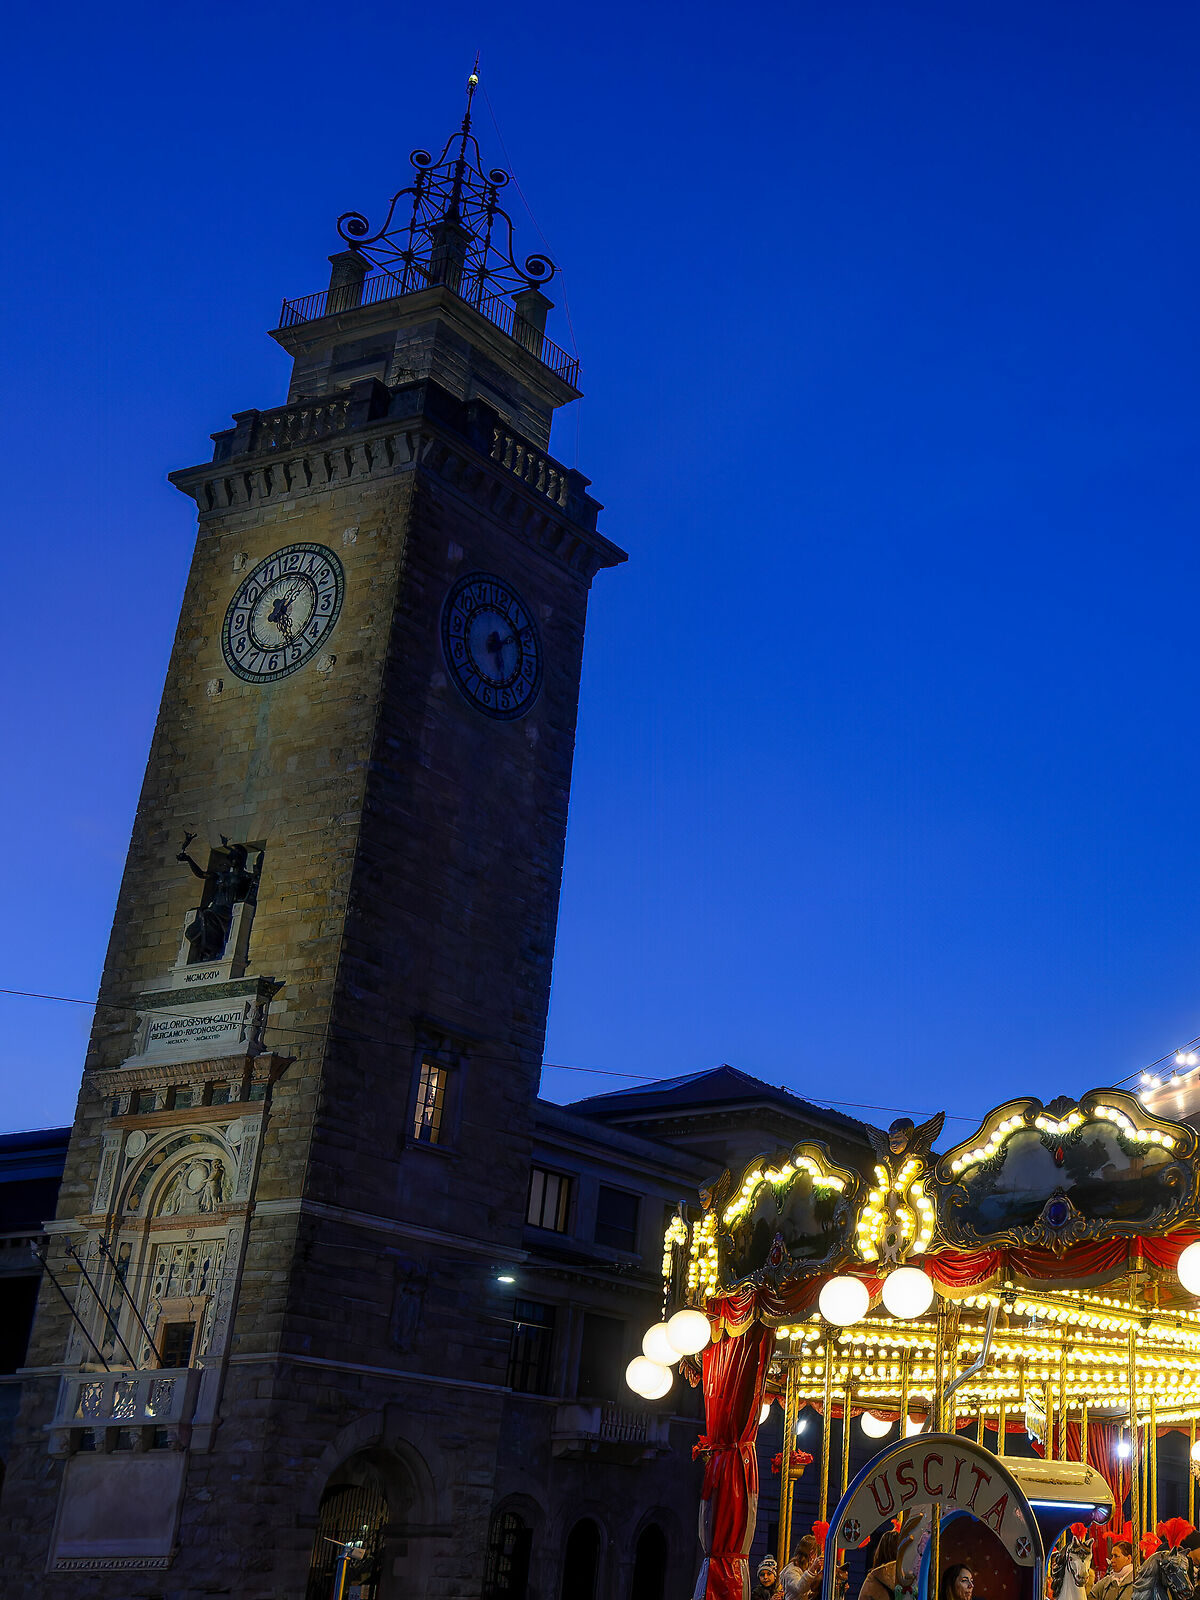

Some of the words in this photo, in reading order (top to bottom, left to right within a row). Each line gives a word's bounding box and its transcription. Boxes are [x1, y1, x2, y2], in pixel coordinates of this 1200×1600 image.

[282, 555, 299, 572] 12
[305, 556, 317, 575] 1
[263, 565, 275, 582] 11
[318, 569, 330, 586] 2
[242, 587, 258, 604] 10
[321, 593, 332, 611] 3
[234, 614, 244, 630] 9
[309, 621, 320, 638] 4
[236, 637, 246, 654] 8
[291, 643, 302, 660] 5
[248, 652, 260, 669] 7
[268, 654, 278, 670] 6
[866, 1452, 1009, 1536] USCITA
